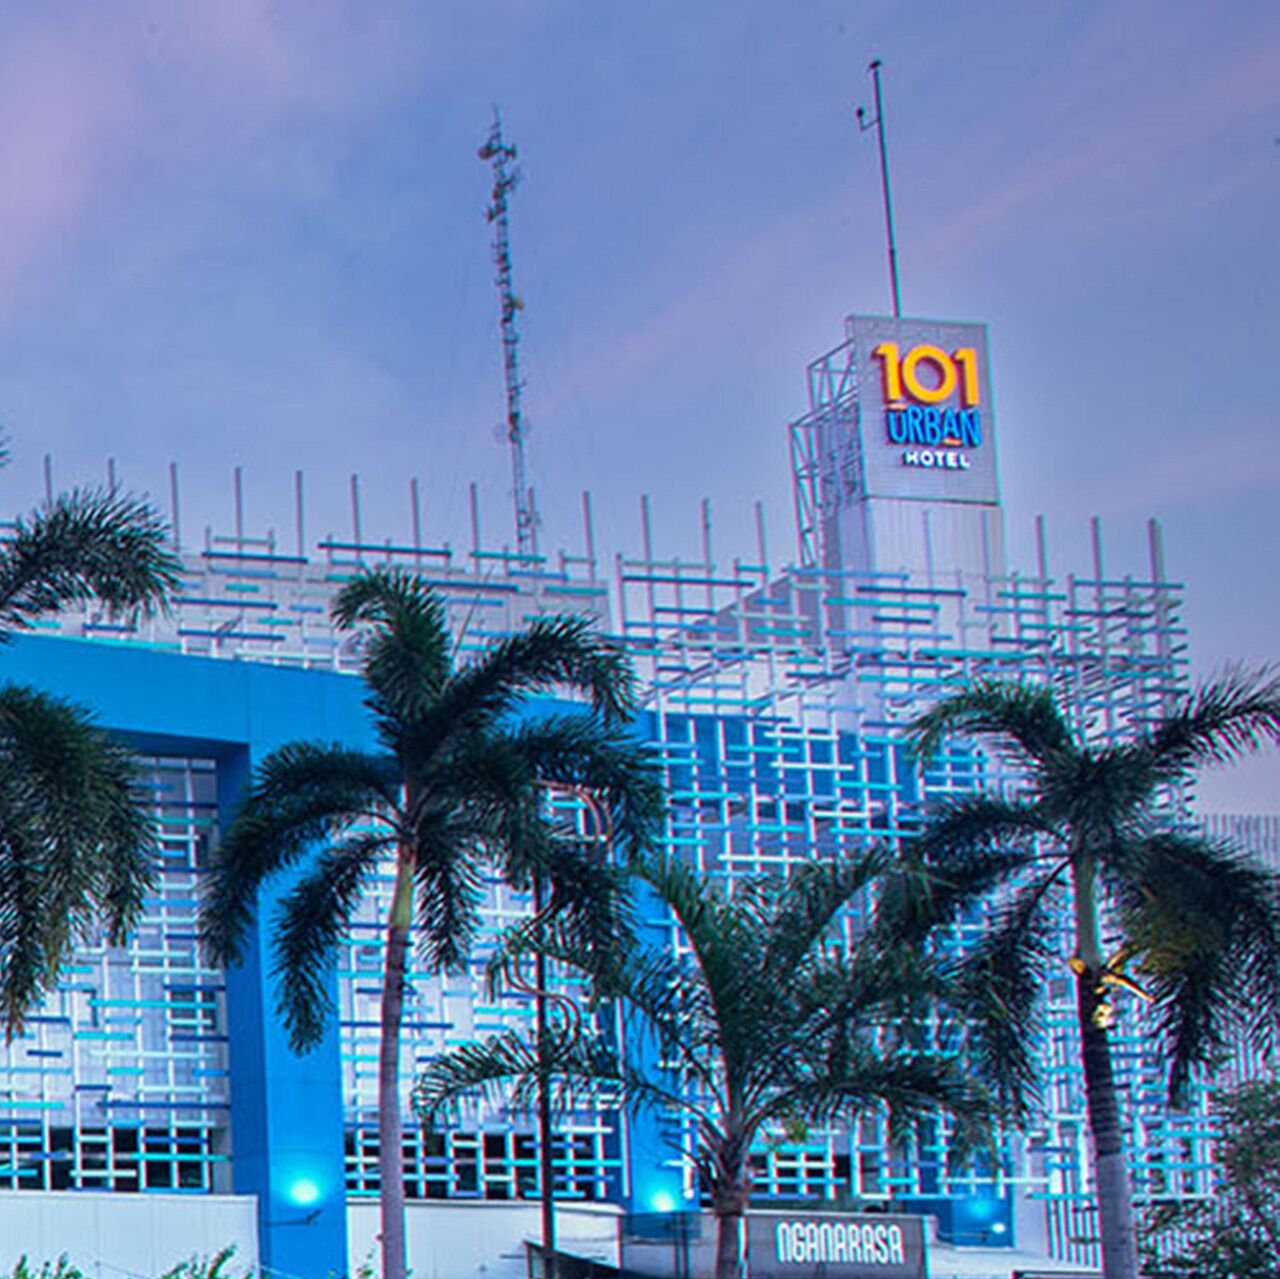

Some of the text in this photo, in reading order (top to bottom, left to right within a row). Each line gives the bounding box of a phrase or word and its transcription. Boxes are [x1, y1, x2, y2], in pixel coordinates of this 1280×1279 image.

[873, 342, 980, 406] 101
[887, 404, 981, 448] URBAN
[904, 451, 971, 469] HOTEL
[777, 1222, 904, 1264] NGANARASA
